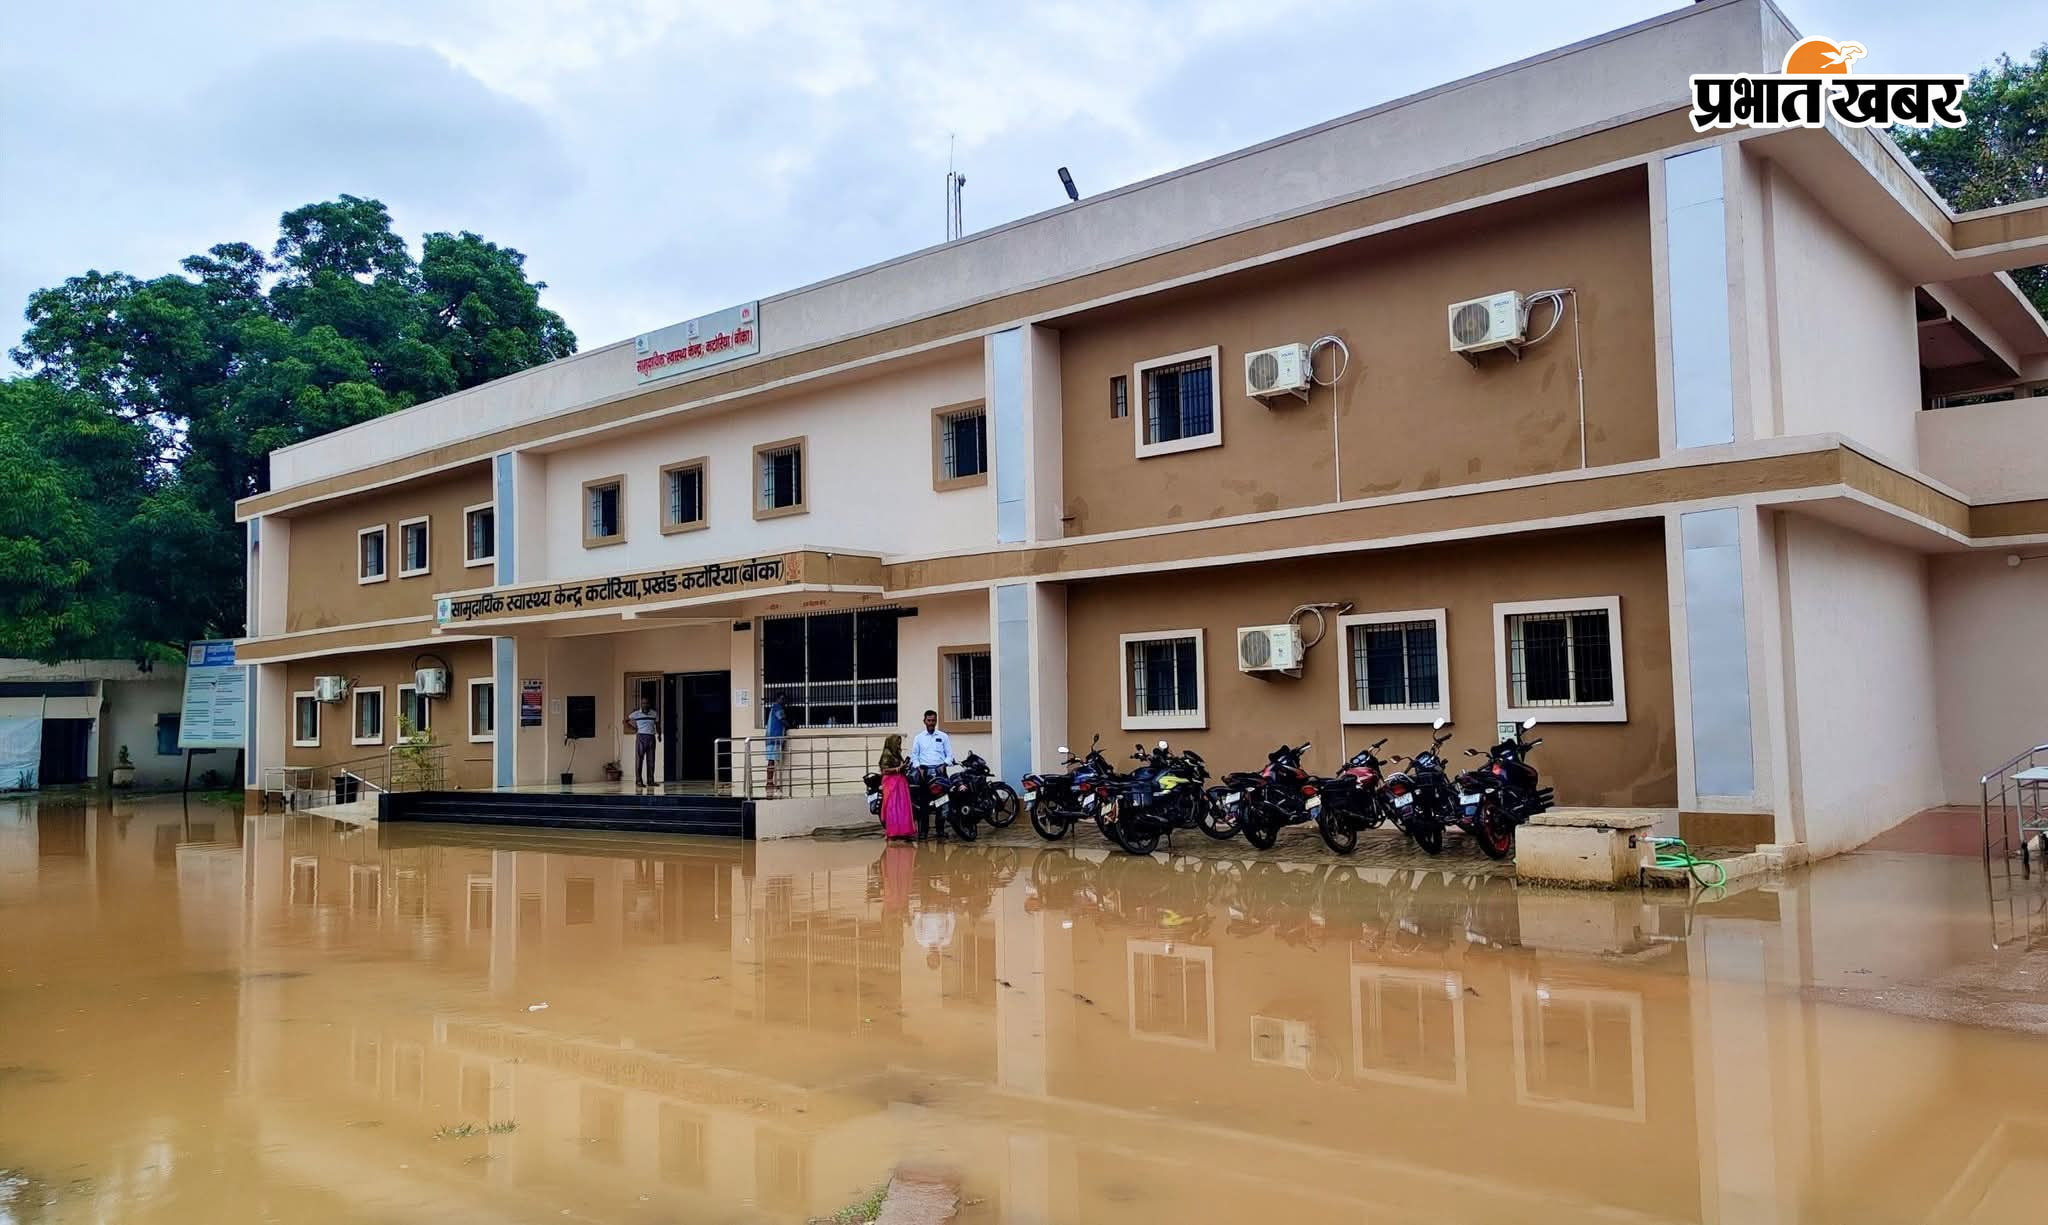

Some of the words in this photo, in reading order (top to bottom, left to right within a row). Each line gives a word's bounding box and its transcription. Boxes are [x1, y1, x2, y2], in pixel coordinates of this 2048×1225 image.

[451, 593, 504, 621] सामुदायिक
[506, 590, 552, 612] स्वास्थ्य
[554, 584, 583, 607] केन्द्र
